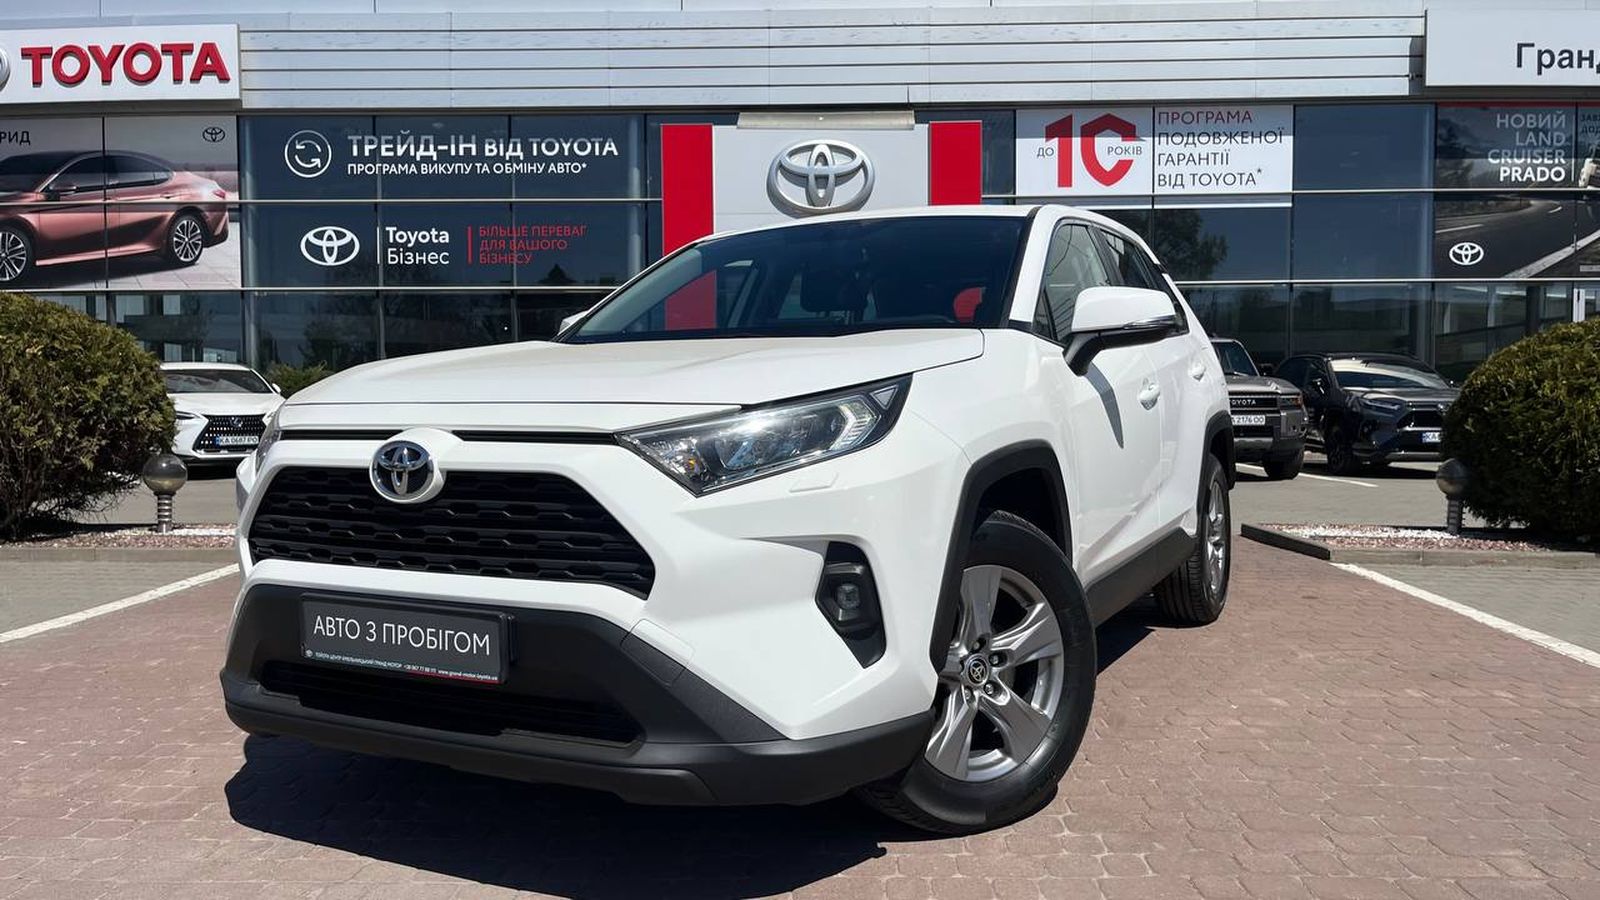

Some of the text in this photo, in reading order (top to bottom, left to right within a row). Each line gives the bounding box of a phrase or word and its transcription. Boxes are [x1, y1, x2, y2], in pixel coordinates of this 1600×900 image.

[21, 43, 230, 87] TOYOTA
[1158, 110, 1252, 125] ПРОГРАМА
[1496, 110, 1566, 128] НОВИЙ
[348, 130, 618, 160] ТРЕЙД-ІН ВІД TOYOTA
[1158, 127, 1284, 147] ПОДОВЖЕНОЇ
[1515, 131, 1566, 146] LAND
[1037, 147, 1054, 157] ДО
[1107, 146, 1142, 156] РОКІВ
[1157, 149, 1230, 166] ГАРАНТІЇ
[1488, 149, 1566, 164] CRUISER
[348, 163, 417, 175] ПРОГРАМА
[421, 163, 472, 174] ВИКУПУ
[475, 163, 490, 174] ТА
[493, 162, 545, 174] ОБМІНУ
[1500, 166, 1566, 182] PRADO
[1158, 173, 1184, 189] ВІД
[385, 226, 449, 247] Toyota
[480, 226, 587, 237] БІЛЬШЕ ПЕРЕВАГ
[481, 239, 568, 251] ДЛЯ ВАШОГО
[388, 248, 449, 264] Бізнес
[480, 253, 532, 264] БІЗНЕСУ
[313, 615, 490, 656] АВТО З ПРОБІГОМ
